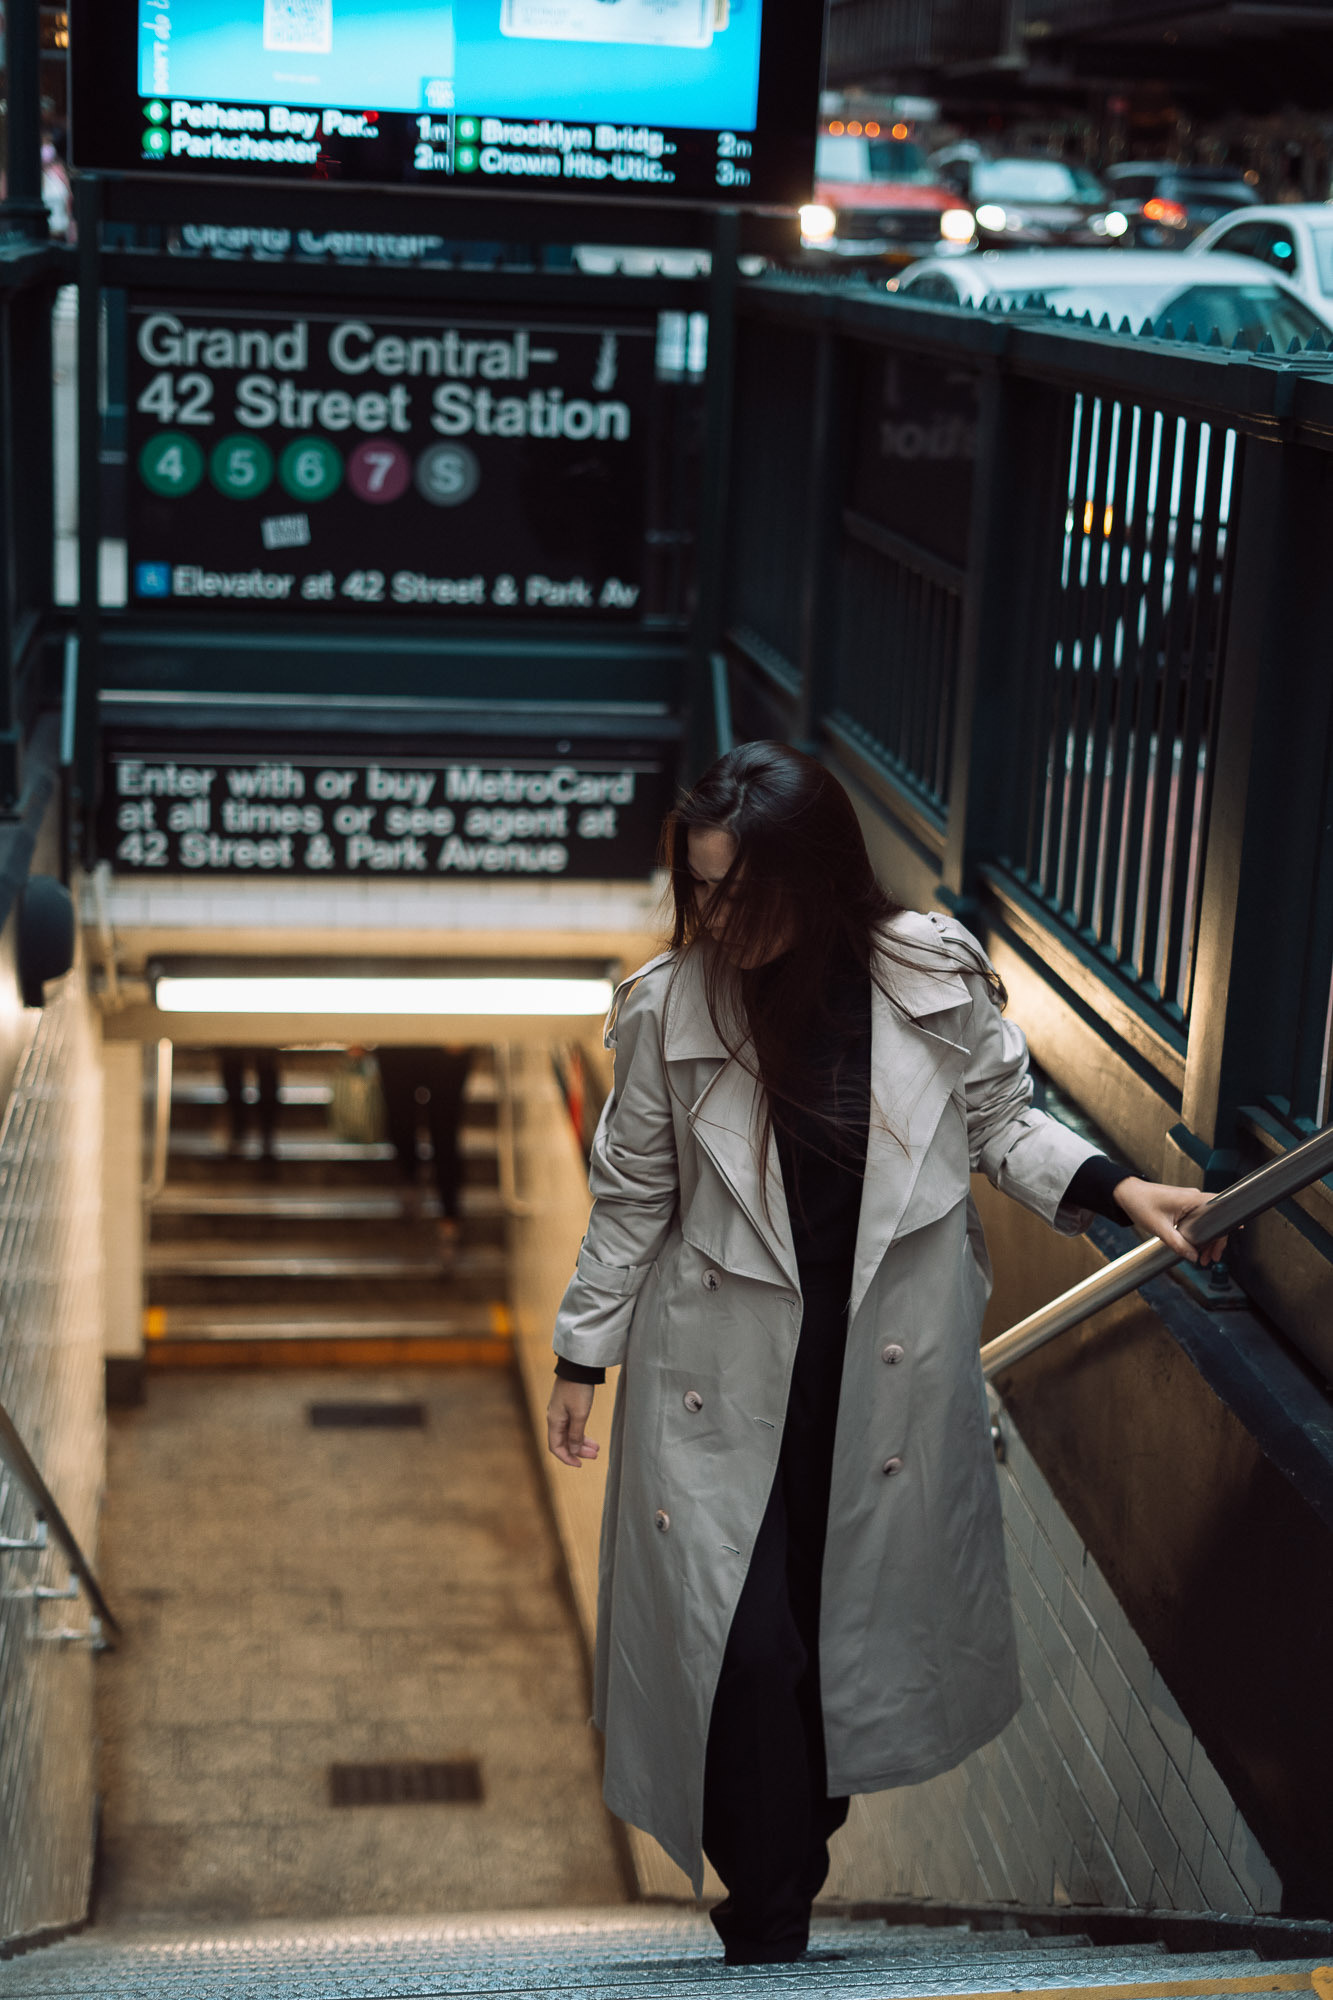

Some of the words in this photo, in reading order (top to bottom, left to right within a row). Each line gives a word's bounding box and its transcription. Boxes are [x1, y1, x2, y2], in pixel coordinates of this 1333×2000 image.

[170, 101, 265, 132] Pelham
[268, 106, 320, 140] Bay
[480, 117, 592, 154] Brooklyn
[170, 130, 322, 164] Parkchester
[479, 147, 561, 178] Crown
[137, 312, 309, 371] Grand
[137, 372, 215, 425] 42
[234, 373, 411, 432] Street
[431, 381, 630, 440] Station
[156, 446, 185, 482] 4
[227, 448, 256, 487] 5
[295, 450, 325, 488] 6
[364, 453, 395, 493] 7
[430, 453, 464, 495] S
[172, 564, 294, 597] Elevator
[302, 571, 334, 599] at
[341, 570, 385, 602] 42
[391, 570, 484, 603] Street
[492, 573, 518, 606] &
[525, 574, 592, 606] Park
[600, 577, 639, 608] Av
[117, 759, 216, 797] Enter
[226, 761, 305, 799] with
[314, 769, 358, 800] or
[366, 764, 436, 806] buy
[445, 764, 636, 804] MetroCard
[117, 799, 156, 831] at
[167, 797, 211, 832] all
[221, 798, 324, 834] times
[333, 805, 376, 835] or
[385, 805, 455, 837] see
[464, 804, 569, 844] agent
[577, 804, 617, 839] at
[117, 830, 169, 866] 42
[178, 830, 295, 868] Street
[304, 833, 335, 869] &
[346, 833, 427, 870] Park
[437, 834, 569, 873] Avenue
